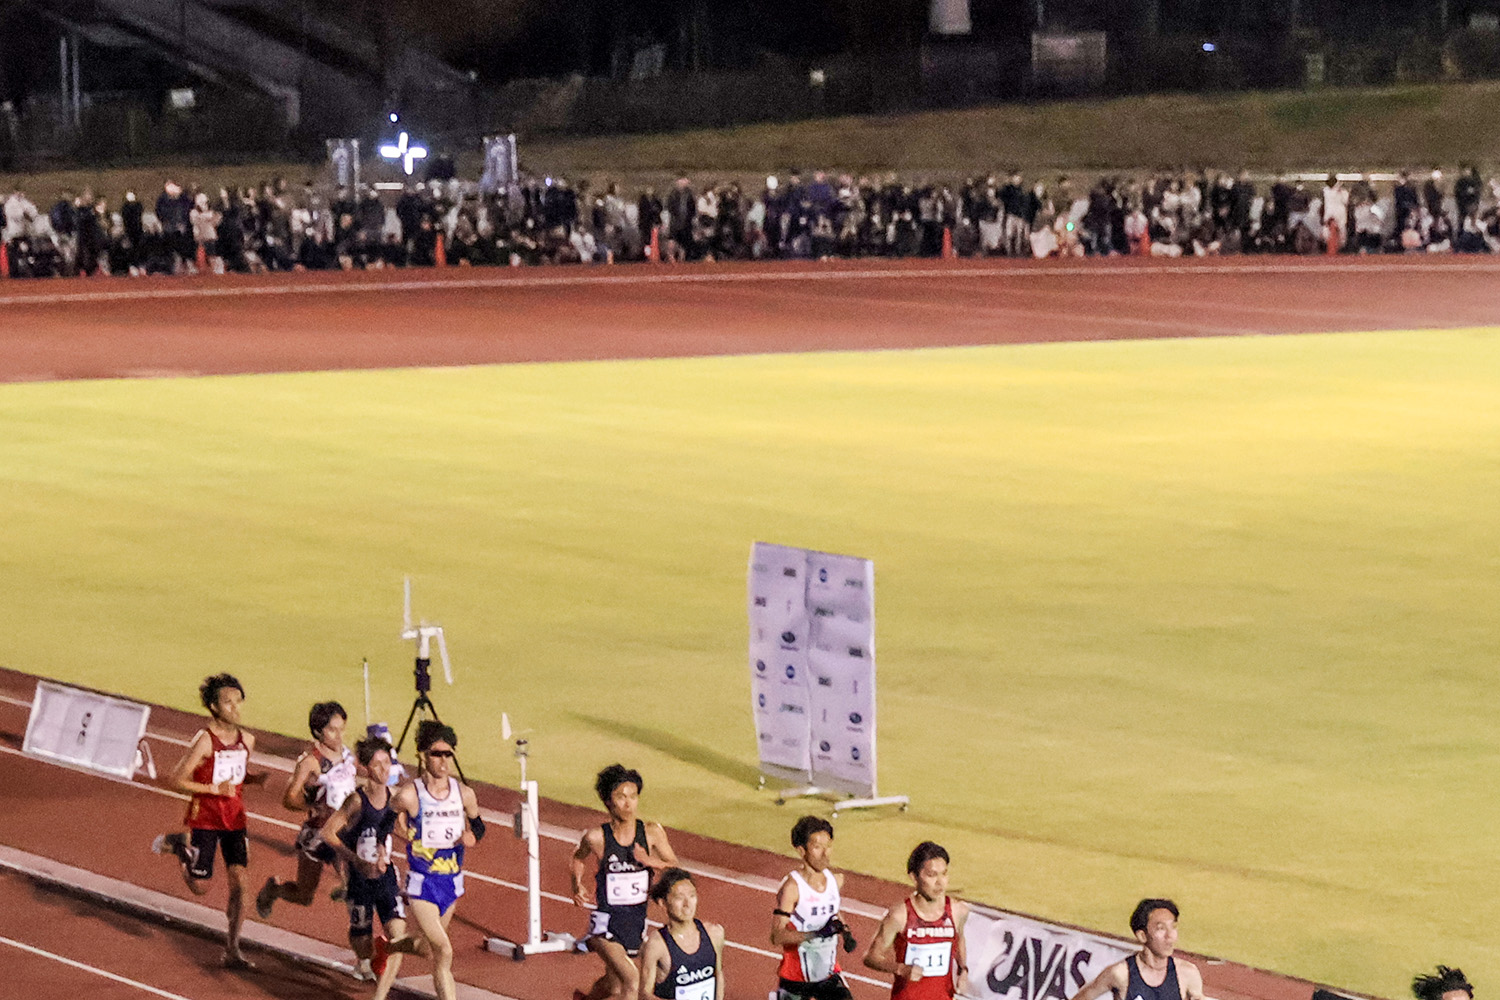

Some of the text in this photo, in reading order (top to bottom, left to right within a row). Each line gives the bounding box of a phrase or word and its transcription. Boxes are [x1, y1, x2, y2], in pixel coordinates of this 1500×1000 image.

[444, 827, 454, 841] 8
[630, 882, 641, 896] 5
[926, 953, 944, 968] 11
[676, 965, 715, 986] GMO
